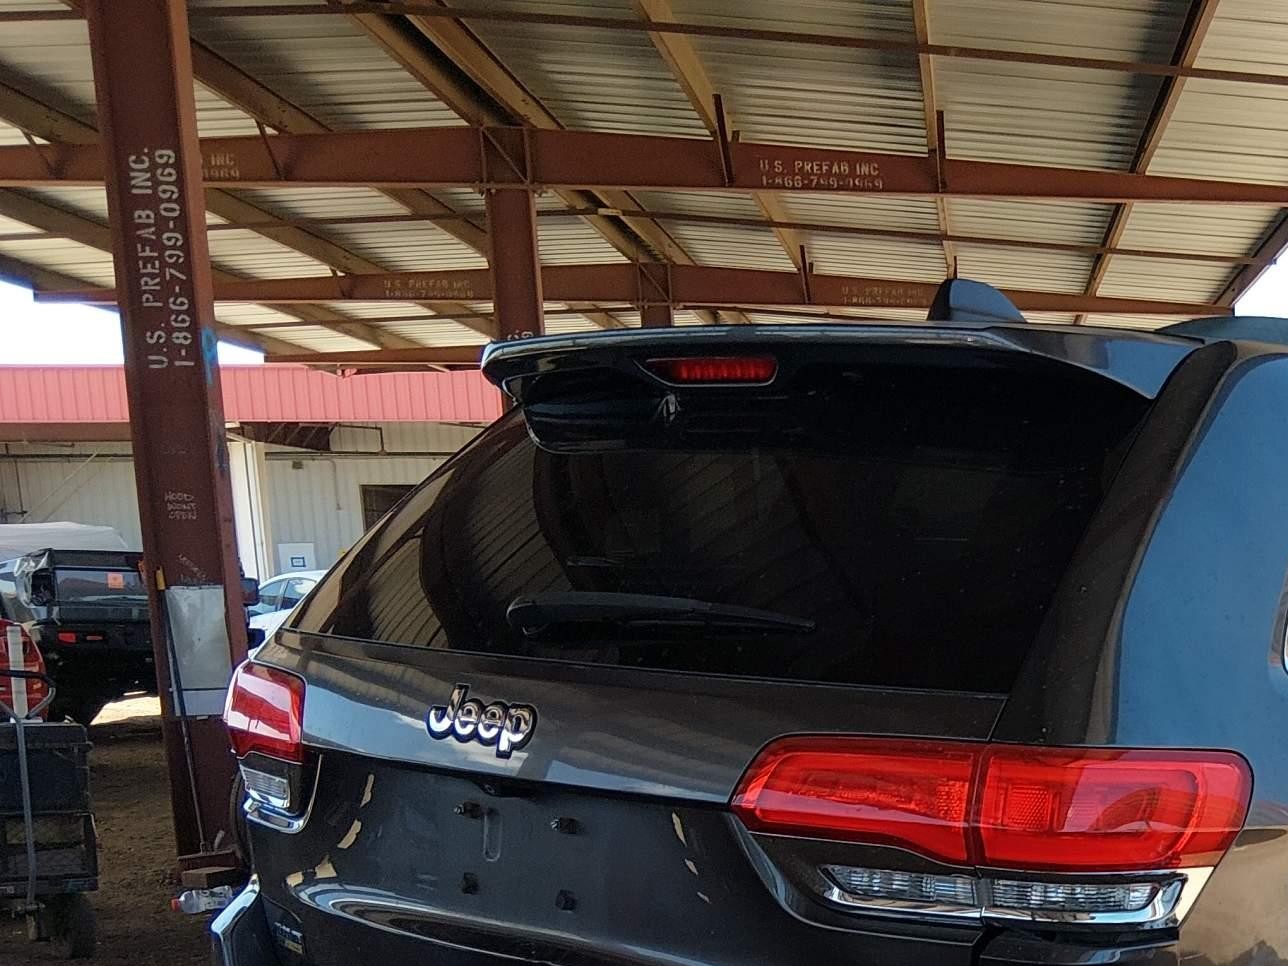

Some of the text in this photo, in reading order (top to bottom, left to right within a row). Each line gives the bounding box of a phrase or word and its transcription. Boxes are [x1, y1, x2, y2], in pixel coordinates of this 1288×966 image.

[794, 160, 849, 175] PREFAB
[855, 161, 880, 176] INC
[128, 147, 169, 369] U.S. PREFAB INC.
[154, 149, 195, 367] 1-866-799-0969
[425, 683, 538, 759] Jeep
